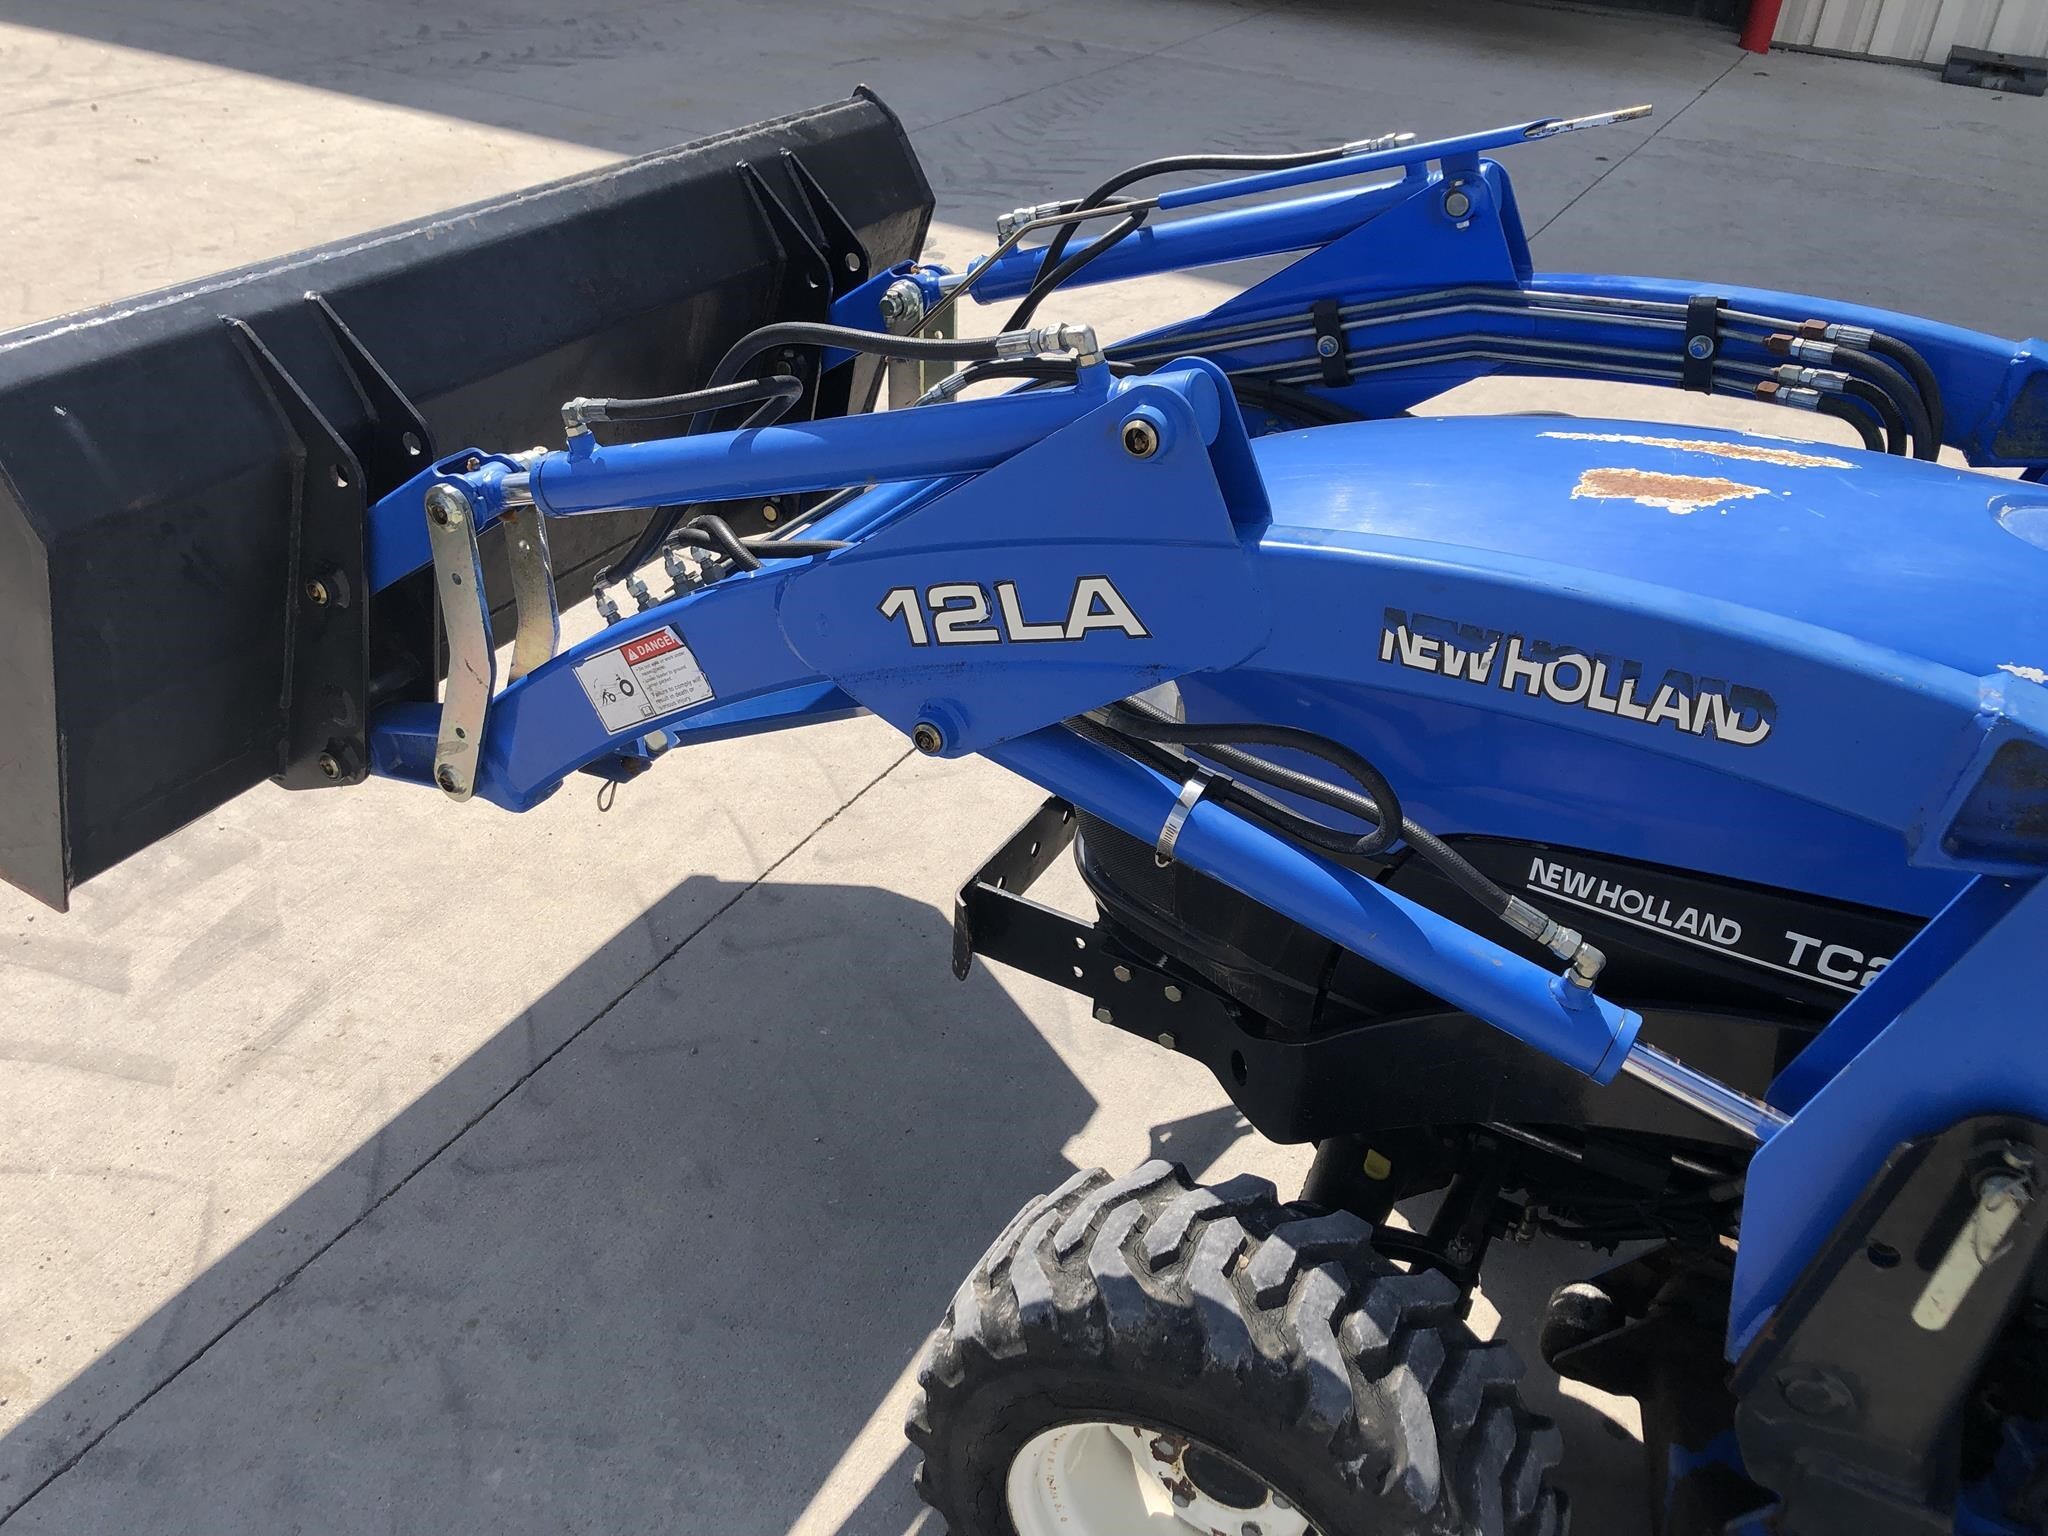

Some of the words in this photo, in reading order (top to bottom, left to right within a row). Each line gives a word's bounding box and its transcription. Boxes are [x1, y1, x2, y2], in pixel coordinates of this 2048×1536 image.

[876, 574, 1153, 647] 12LA
[1377, 606, 1504, 685] NEW
[1499, 632, 1777, 747] HOLLAND
[1528, 857, 1596, 898] NEW
[1595, 883, 1742, 946] HOLLAND
